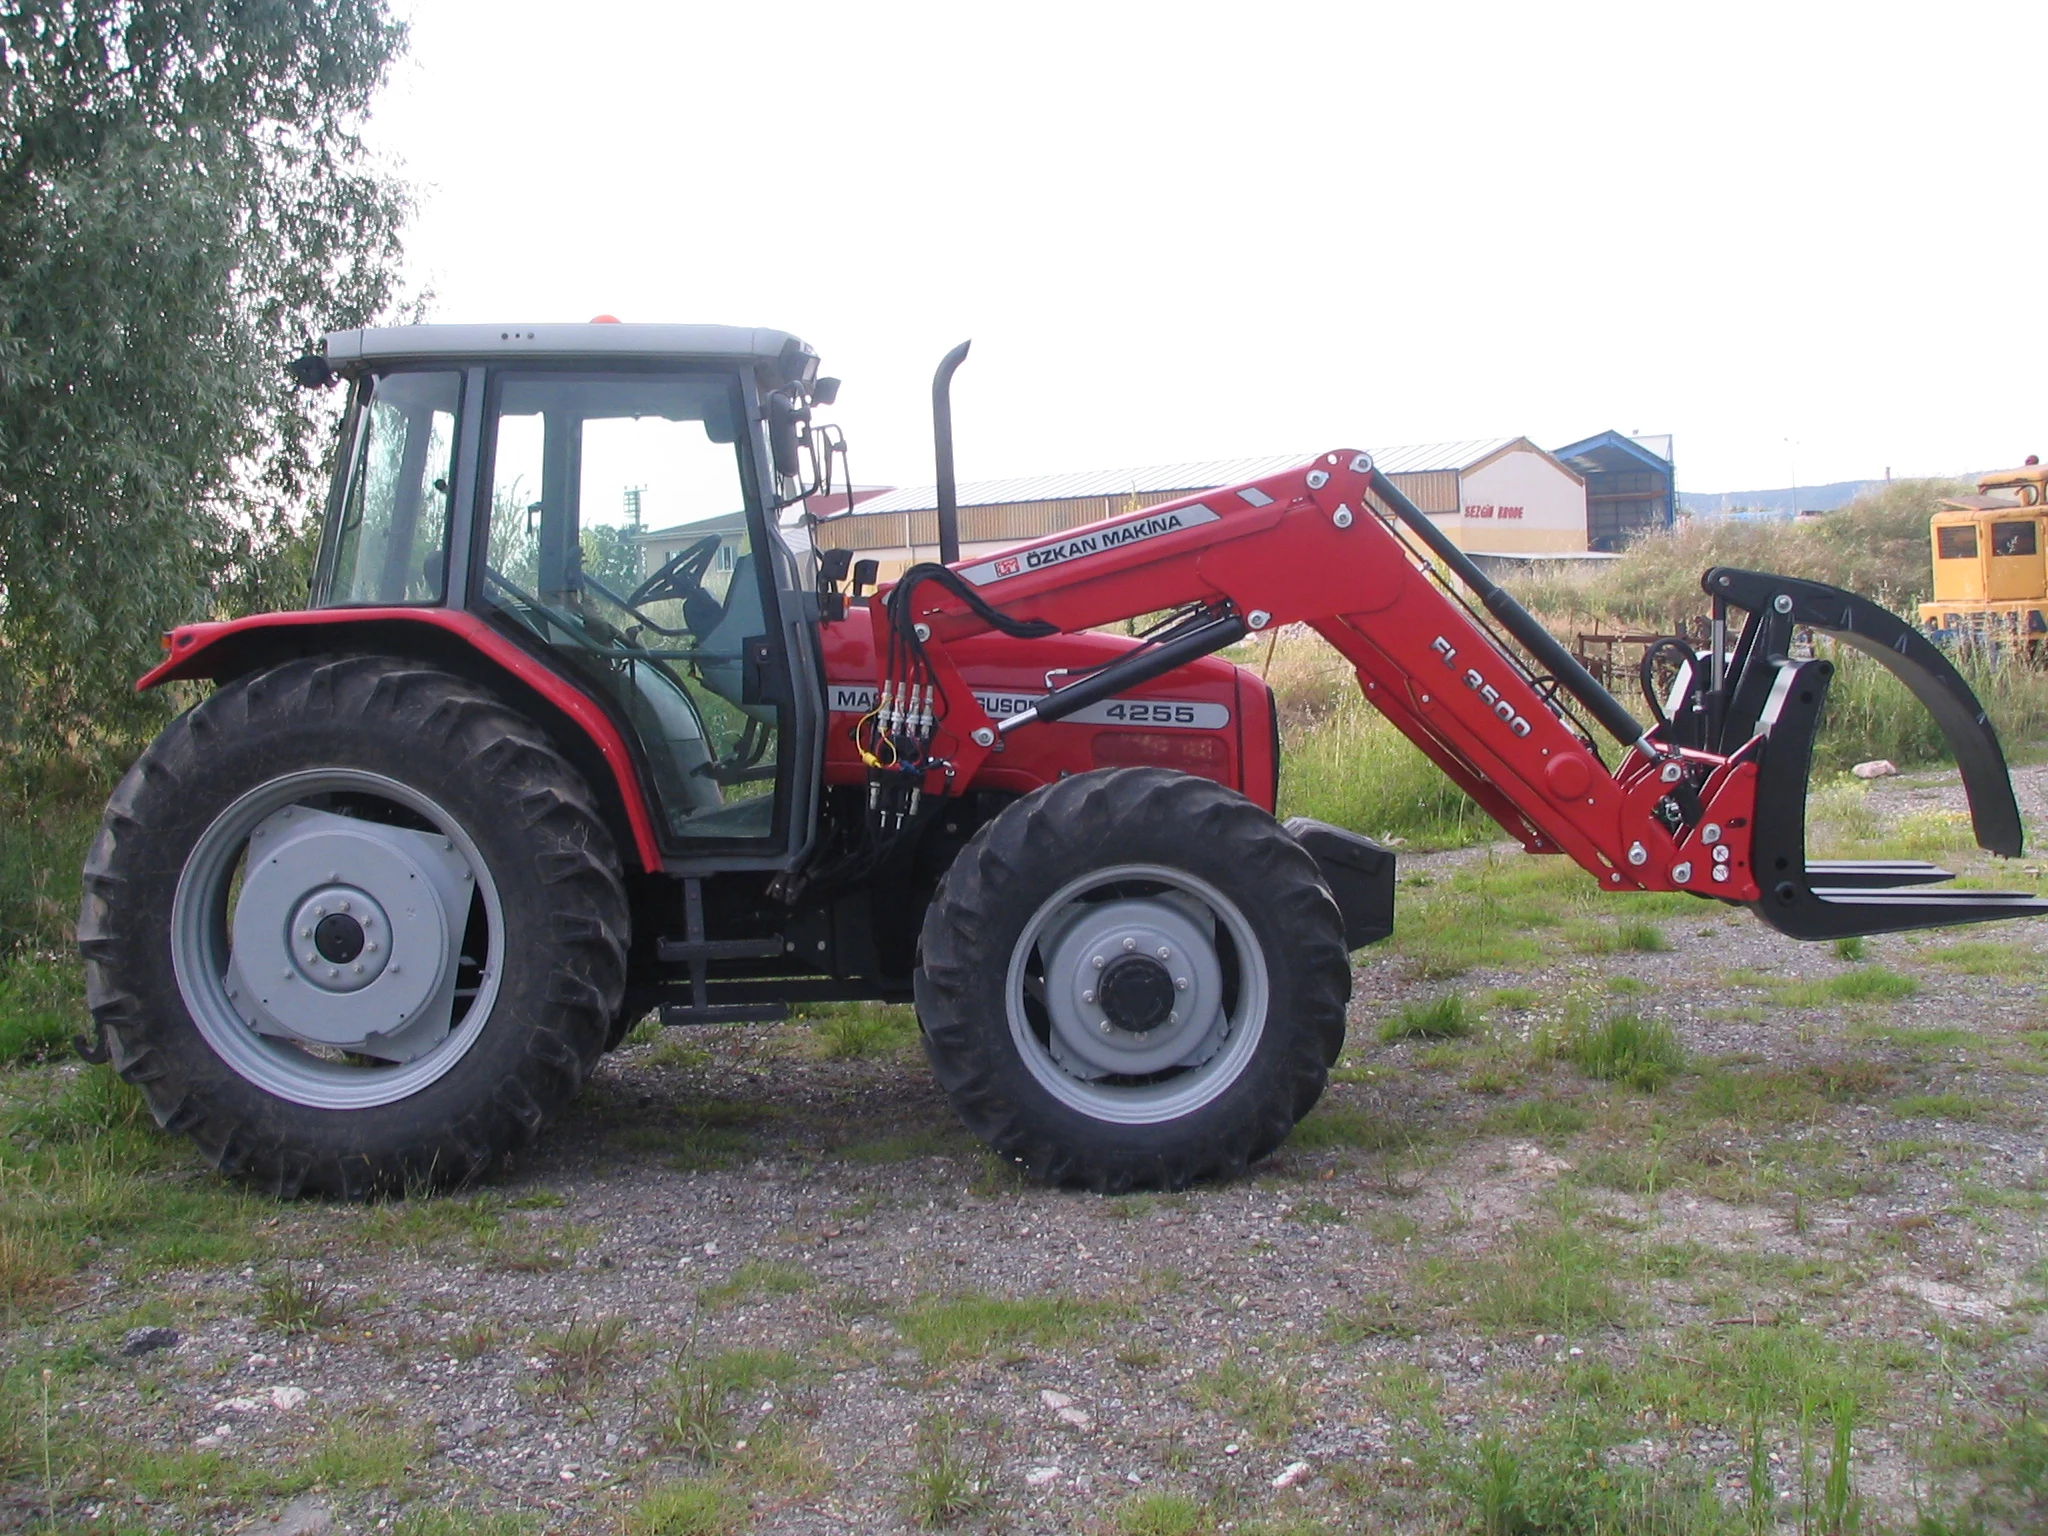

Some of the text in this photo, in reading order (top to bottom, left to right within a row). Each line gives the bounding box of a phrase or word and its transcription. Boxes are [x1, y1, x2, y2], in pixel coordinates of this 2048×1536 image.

[1026, 537, 1097, 569] ÖZKAN
[1101, 514, 1183, 548] MAKİNA
[1106, 703, 1195, 723] 4255
[1429, 635, 1533, 738] FL 3500
